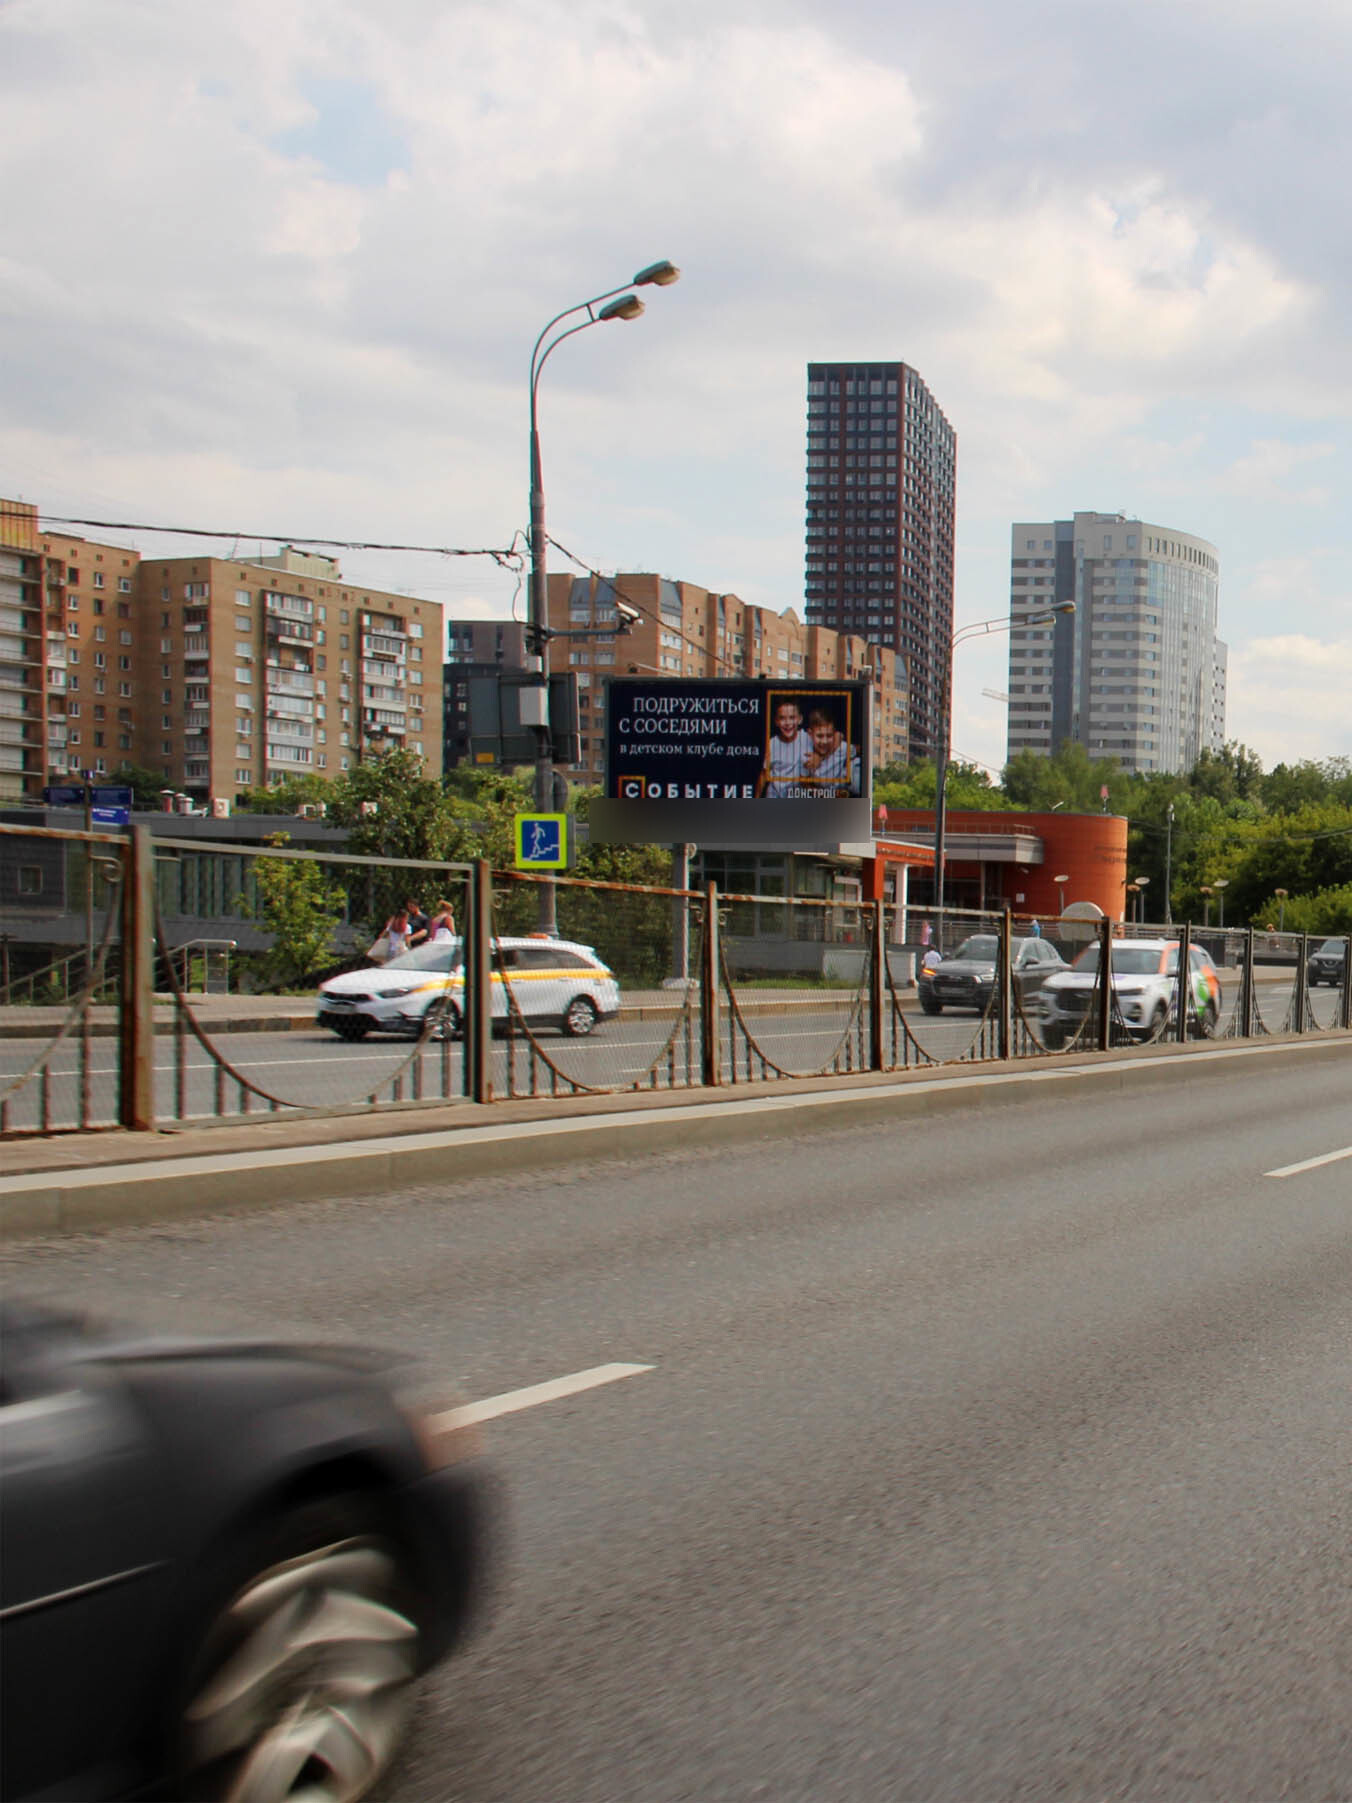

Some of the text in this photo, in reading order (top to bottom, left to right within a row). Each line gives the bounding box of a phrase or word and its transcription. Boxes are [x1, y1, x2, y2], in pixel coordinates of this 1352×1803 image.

[633, 697, 759, 715] ПОДРУЖИТЬСЯ
[619, 718, 727, 736] С СОСЕДЯМИ
[619, 742, 759, 758] в детском клубе дома
[625, 782, 754, 798] СОБЫТИЕ
[787, 786, 836, 798] ДОНСТРОЙ
